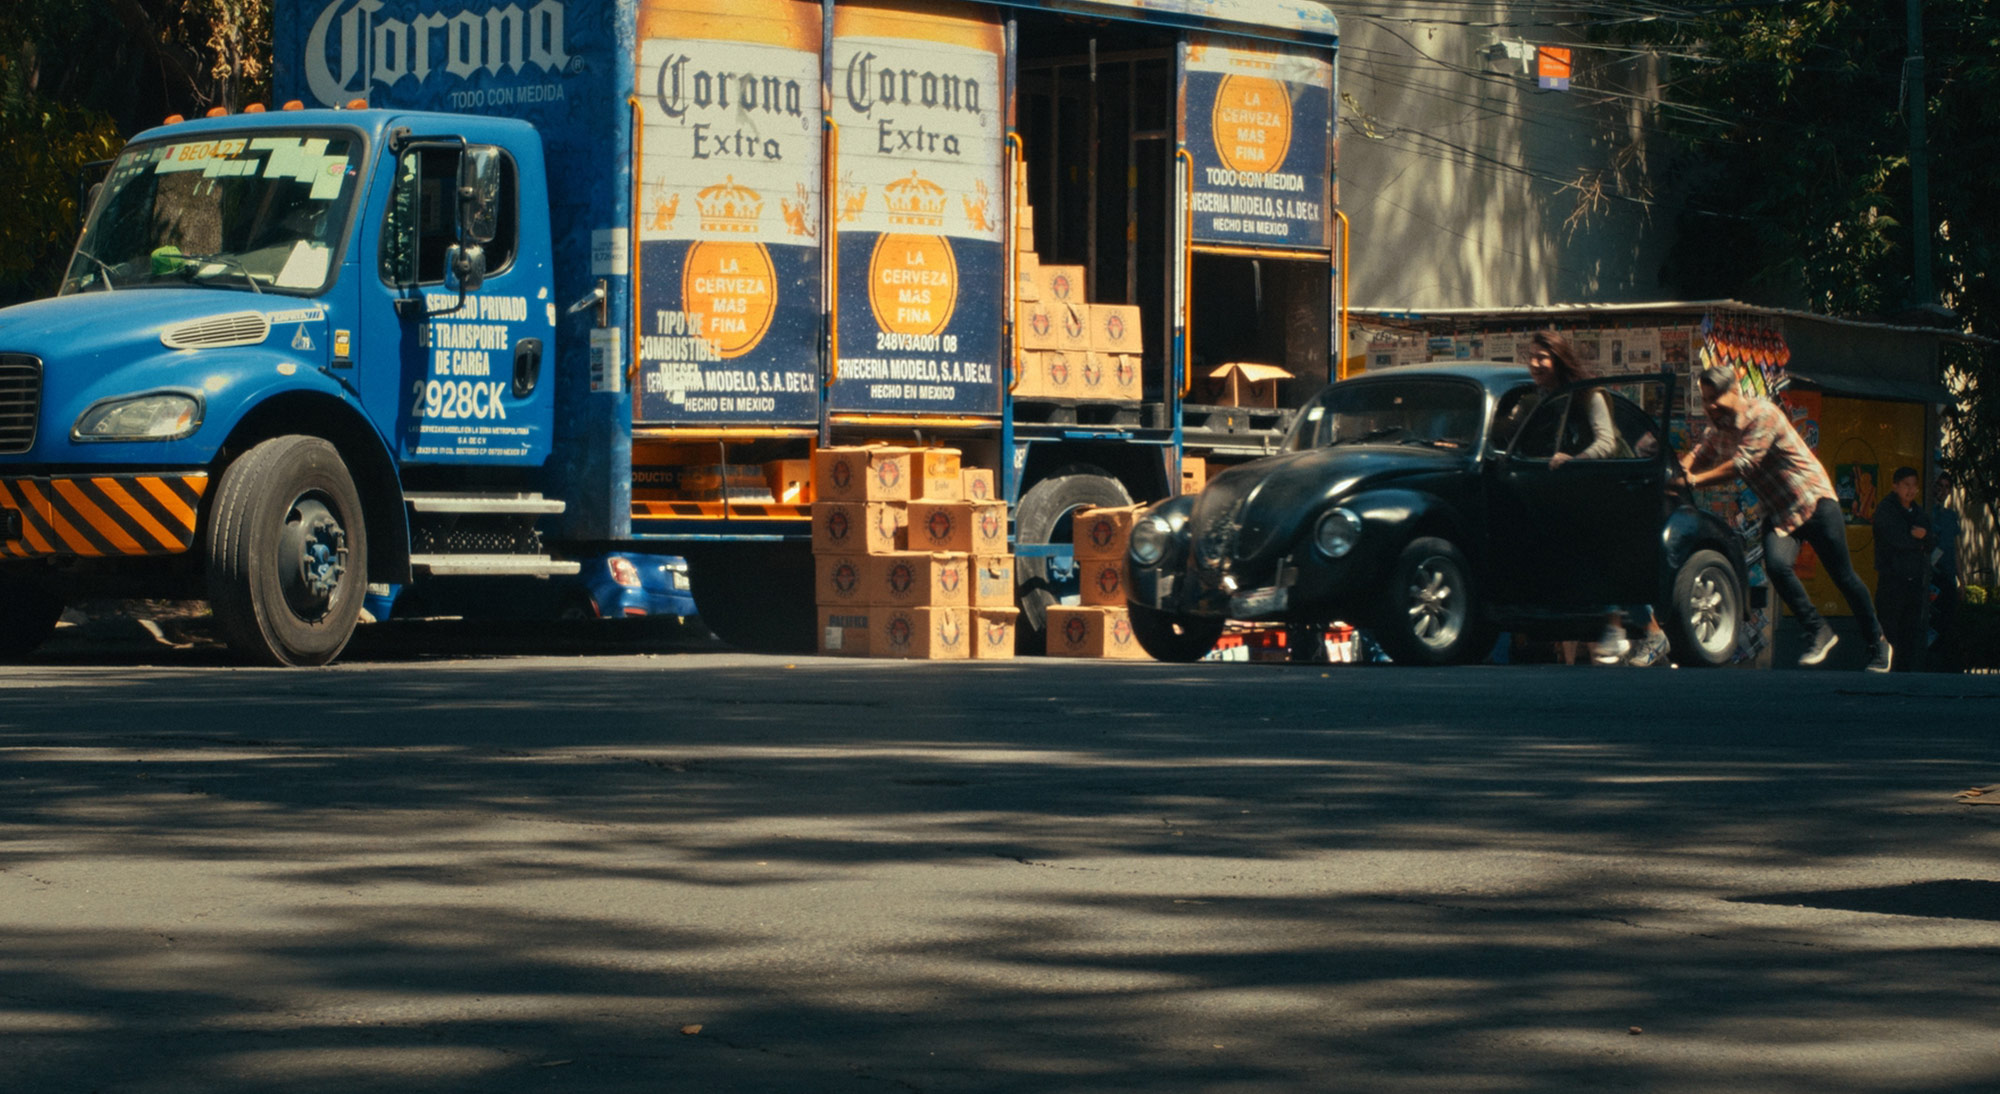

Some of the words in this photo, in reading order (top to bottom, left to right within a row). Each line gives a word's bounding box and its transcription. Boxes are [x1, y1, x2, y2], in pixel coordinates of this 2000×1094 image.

[305, 0, 572, 108] Corona
[452, 90, 485, 109] TODO
[488, 87, 514, 107] CON
[516, 84, 565, 105] MEDIDA
[657, 53, 803, 126] Corona
[846, 51, 981, 120] Corona
[1244, 92, 1261, 106] LA
[1222, 108, 1281, 128] CERVEZA
[692, 122, 782, 160] Extra
[878, 118, 960, 156] Extra
[1237, 128, 1266, 144] MAS
[1236, 146, 1266, 161] FINA
[1206, 168, 1237, 188] TODO
[1239, 171, 1263, 189] CON
[1264, 173, 1304, 192] MEDIDA
[1213, 218, 1241, 233] HECHO
[1242, 220, 1255, 233] EN
[1256, 221, 1289, 236] MEXICO
[720, 259, 739, 273] LA
[907, 251, 925, 265] LA
[695, 277, 766, 294] CERVEZA
[882, 269, 949, 286] CERVEZA
[479, 295, 527, 322] PRIVADO
[713, 298, 747, 314] MAS
[897, 308, 931, 323] FINA
[657, 310, 685, 335] TIPO
[688, 312, 704, 335] DE
[711, 318, 747, 332] FINA
[419, 322, 433, 348] DE
[436, 323, 508, 350] TRANSPORTE
[435, 350, 450, 375] DE
[453, 350, 490, 376] CARGA
[890, 359, 941, 383] MODELO,
[964, 363, 977, 383] DE
[705, 370, 760, 394] MODELO,
[786, 372, 800, 392] DE
[871, 384, 902, 399] HECHO
[904, 385, 917, 399] EN
[919, 385, 955, 400] MEXICO
[412, 379, 507, 419] 2928CK
[685, 397, 718, 412] HECHO
[720, 398, 734, 412] EN
[736, 397, 775, 412] MEXICO
